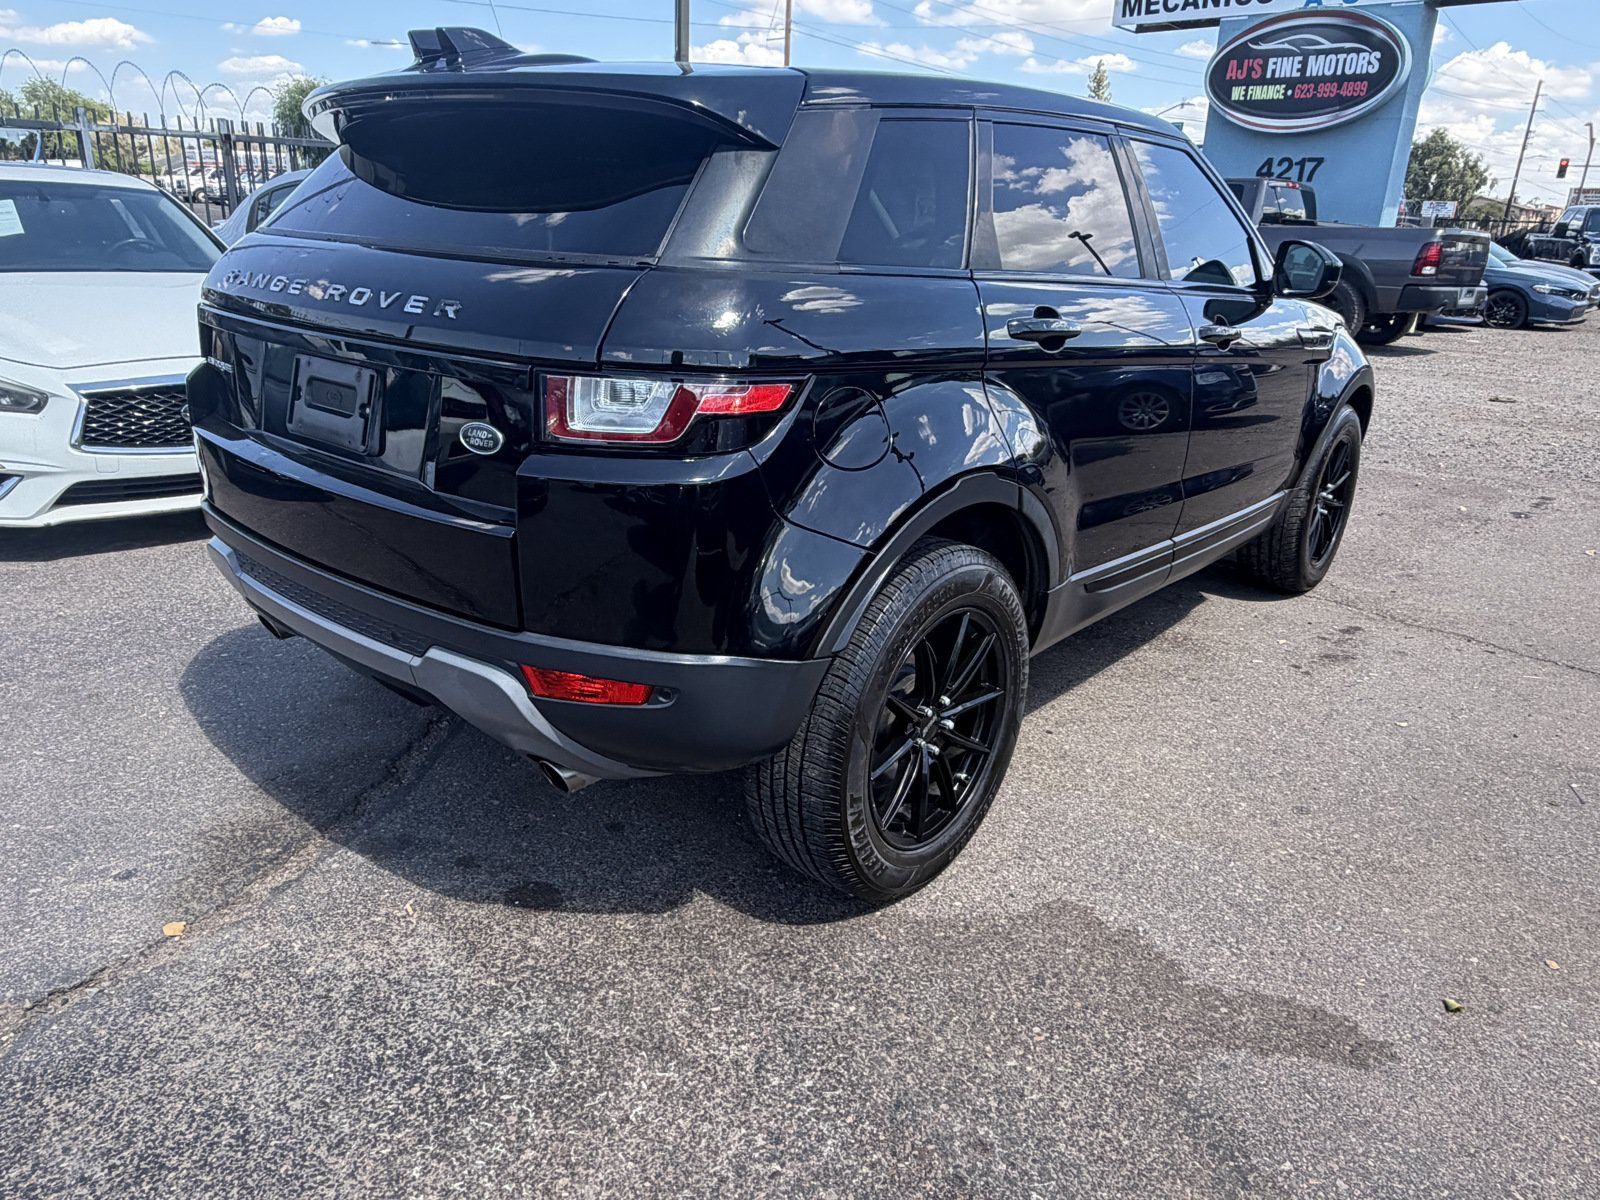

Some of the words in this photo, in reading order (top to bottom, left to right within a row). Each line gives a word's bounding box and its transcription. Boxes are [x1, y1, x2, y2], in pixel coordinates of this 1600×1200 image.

[1121, 0, 1273, 18] MECA
[1226, 58, 1263, 80] AJ'S
[1266, 57, 1302, 79] FINE
[1306, 51, 1381, 77] MOTORS
[1231, 86, 1246, 101] WE
[1247, 84, 1286, 100] FINANCE
[1294, 81, 1368, 98] 623-999-4899
[1255, 157, 1325, 182] 4217
[223, 269, 309, 296] RANGE
[323, 283, 463, 320] ROVER
[468, 428, 488, 439] LAND
[469, 437, 494, 448] ROVER
